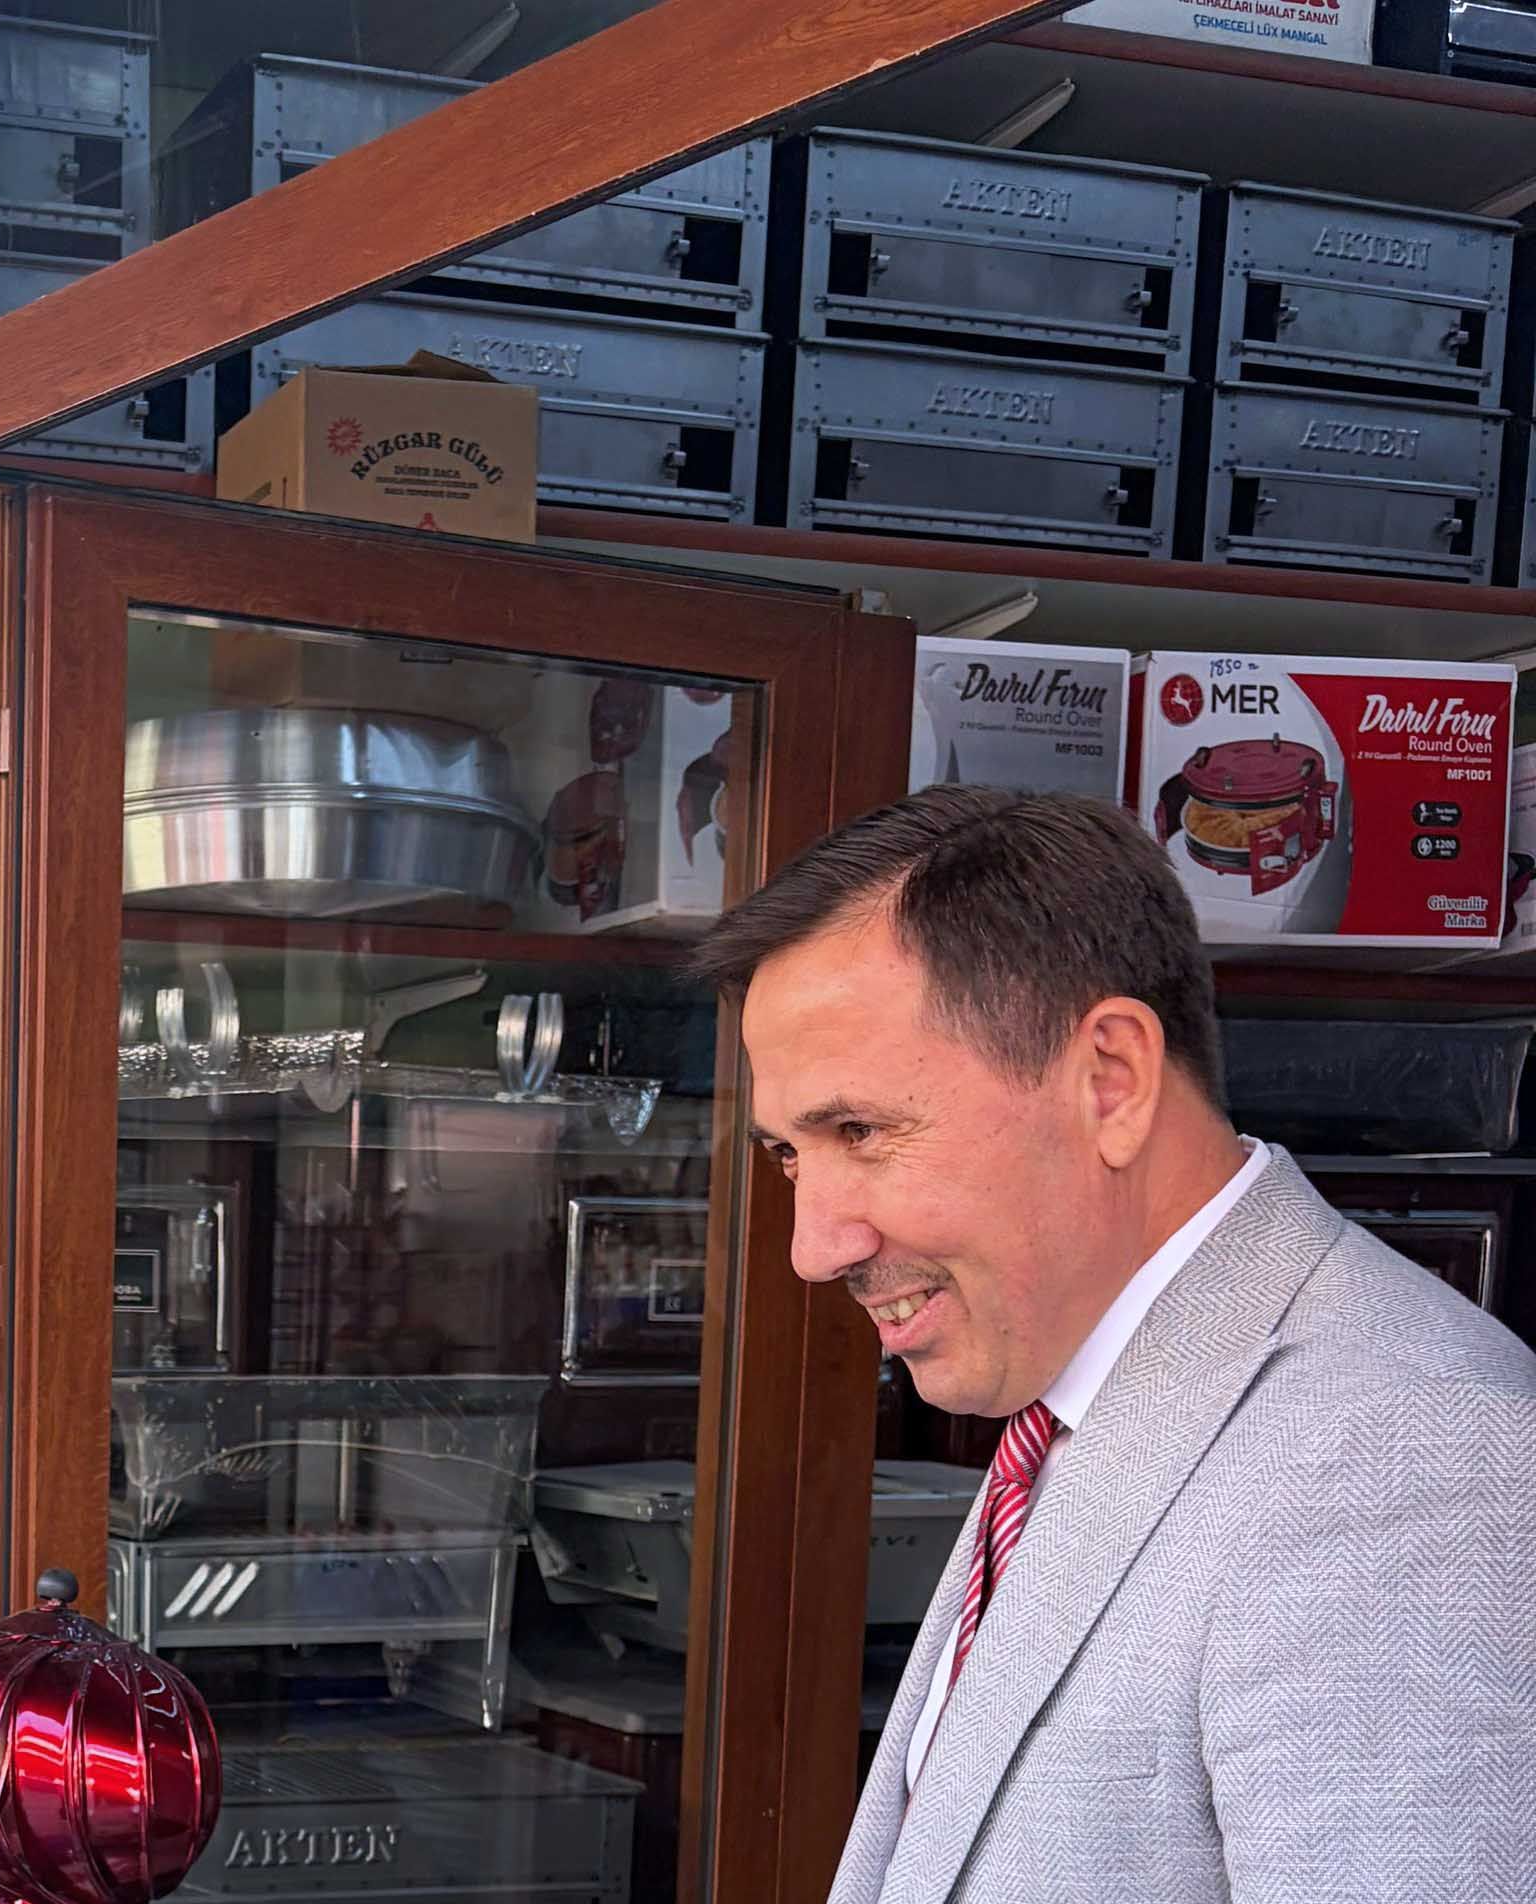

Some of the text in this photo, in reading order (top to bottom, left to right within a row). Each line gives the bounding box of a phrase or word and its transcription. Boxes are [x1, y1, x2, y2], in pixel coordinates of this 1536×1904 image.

[1255, 3, 1295, 19] İMALAT
[1298, 10, 1339, 26] SANAYİ
[1257, 22, 1278, 37] LÜX
[1281, 28, 1327, 45] MANGAL
[942, 179, 1072, 222] AKTEN
[1311, 224, 1431, 271] AKTEN
[927, 381, 1054, 425] AKTEN
[1299, 419, 1420, 461] AKTEN
[350, 432, 504, 484] RÜZGAR GÜLÜ
[960, 663, 1044, 703] Davul
[1210, 684, 1280, 715] MER
[1015, 708, 1062, 725] Round
[1358, 694, 1436, 735] Davul
[1408, 736, 1492, 754] Round Oven
[1446, 768, 1492, 782] MF1001
[1427, 895, 1488, 912] Güvenilir
[1444, 913, 1487, 929] Marka
[225, 1825, 400, 1868] AKTEN
